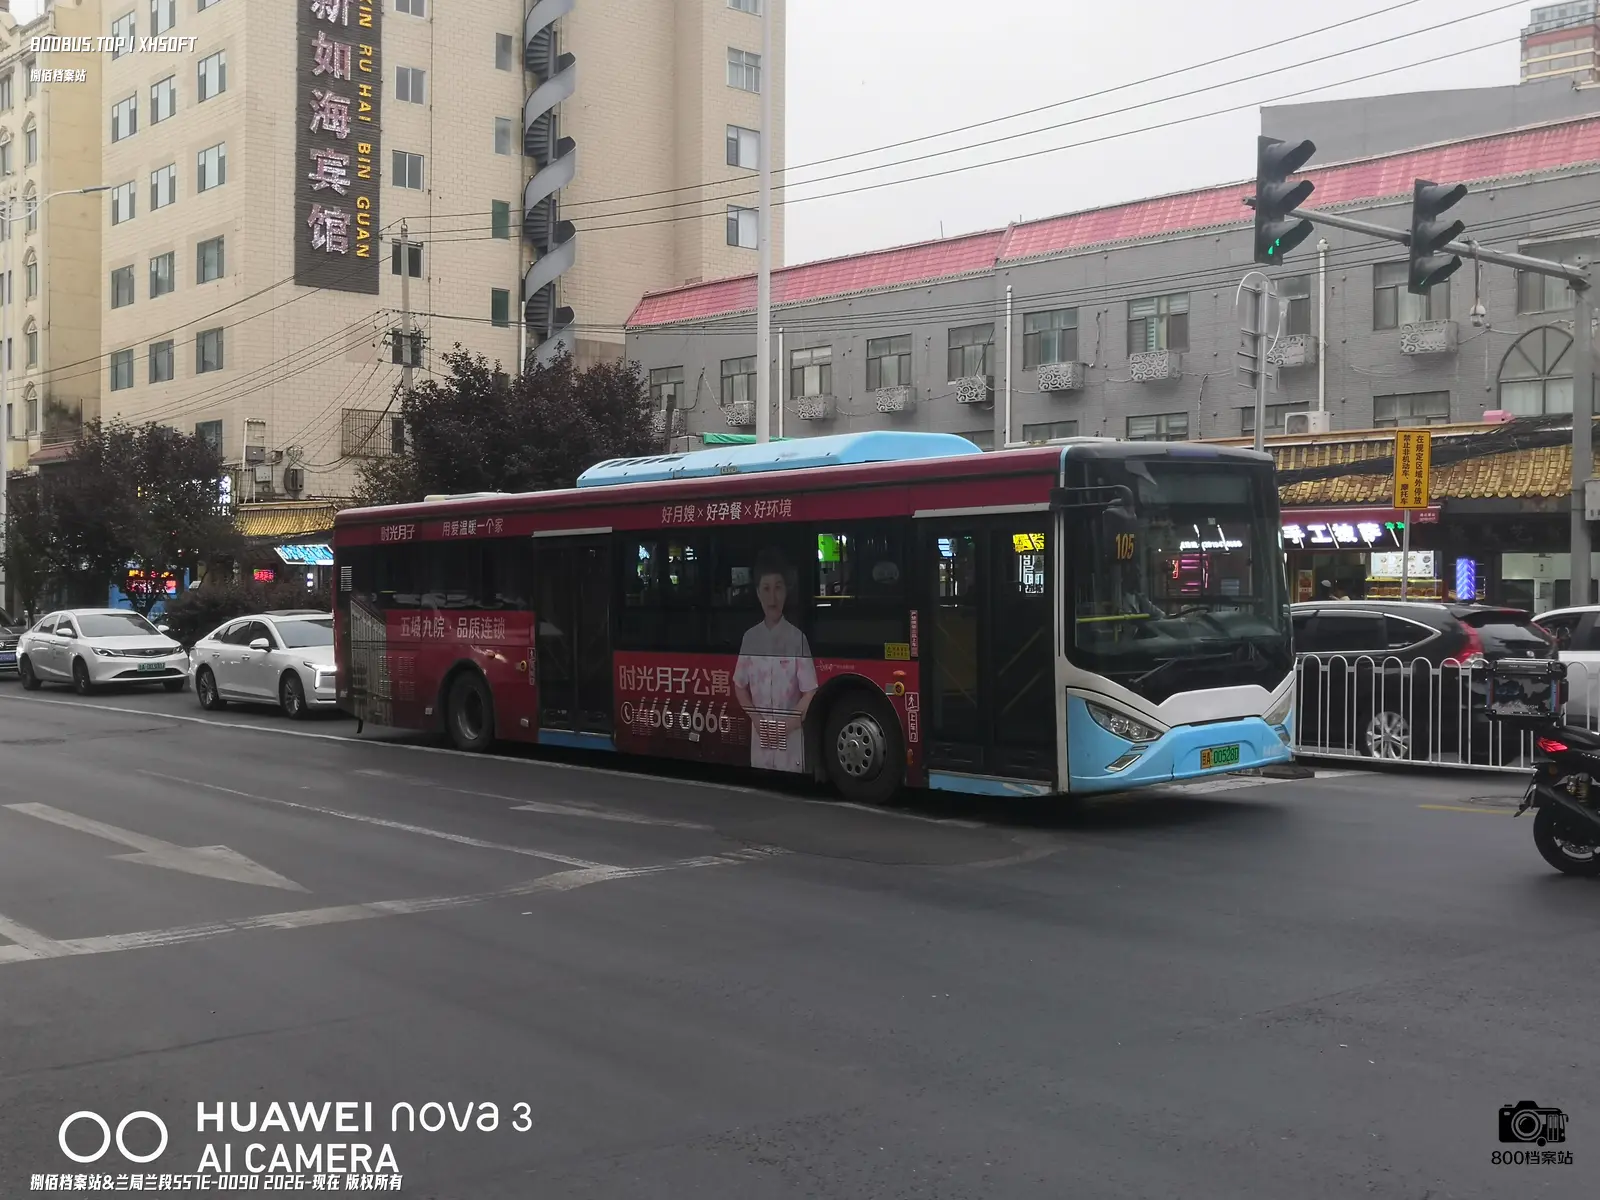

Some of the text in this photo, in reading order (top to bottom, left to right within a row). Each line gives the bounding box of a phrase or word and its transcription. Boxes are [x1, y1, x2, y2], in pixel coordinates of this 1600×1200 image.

[359, 44, 372, 72] RU
[358, 83, 372, 121] HAI
[357, 143, 371, 178] BIN
[356, 196, 371, 257] GUAN
[1414, 435, 1424, 505] 在规定区域外停放
[380, 524, 415, 541] 时光月子
[442, 518, 504, 537] 用爱温暖一个家
[1116, 534, 1135, 559] 105
[619, 665, 731, 697] 时光月子公寓
